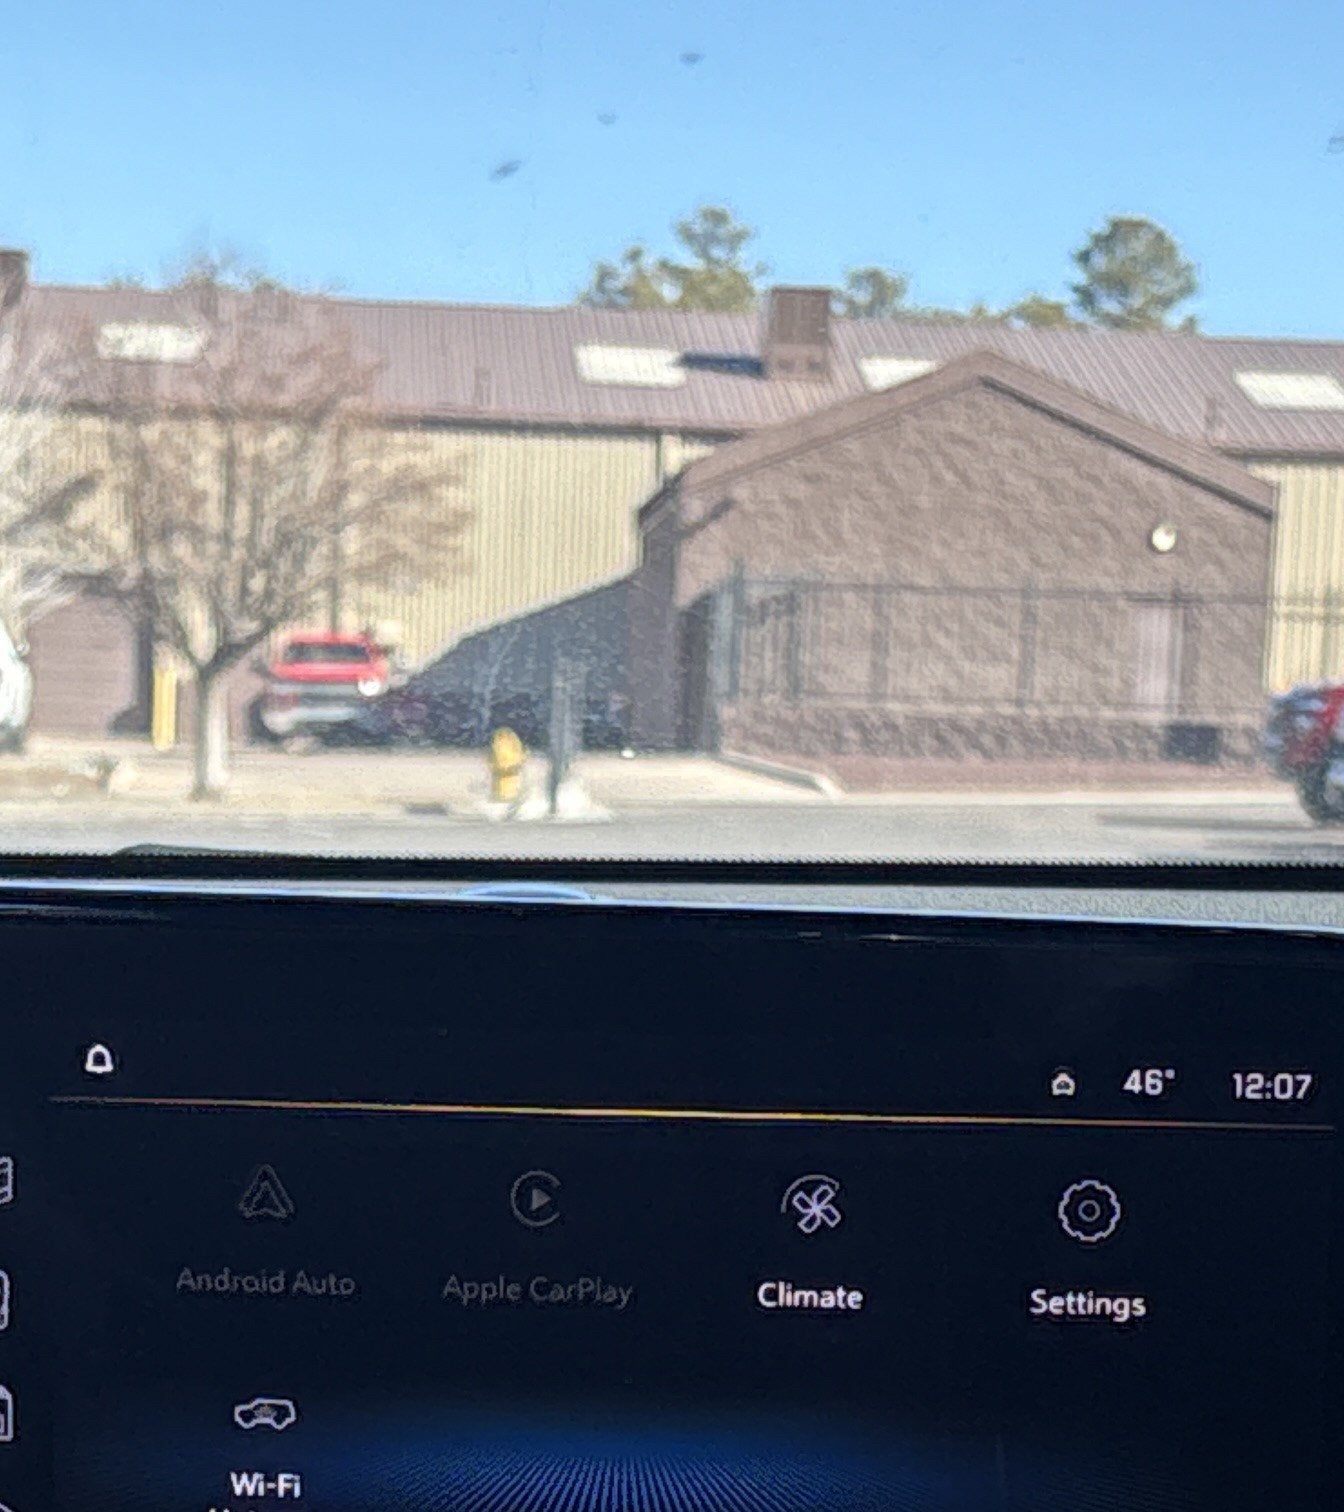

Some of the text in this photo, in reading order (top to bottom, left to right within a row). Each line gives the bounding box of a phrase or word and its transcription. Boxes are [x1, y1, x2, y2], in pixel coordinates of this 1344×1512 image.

[1123, 1069, 1176, 1096] 46°
[1232, 1072, 1313, 1100] 12:07
[175, 1267, 356, 1297] Android Auto
[443, 1275, 633, 1309] Apple CarPlay
[758, 1282, 864, 1311] Climate
[1030, 1289, 1147, 1322] Settings
[230, 1472, 302, 1499] Wi-Fi
